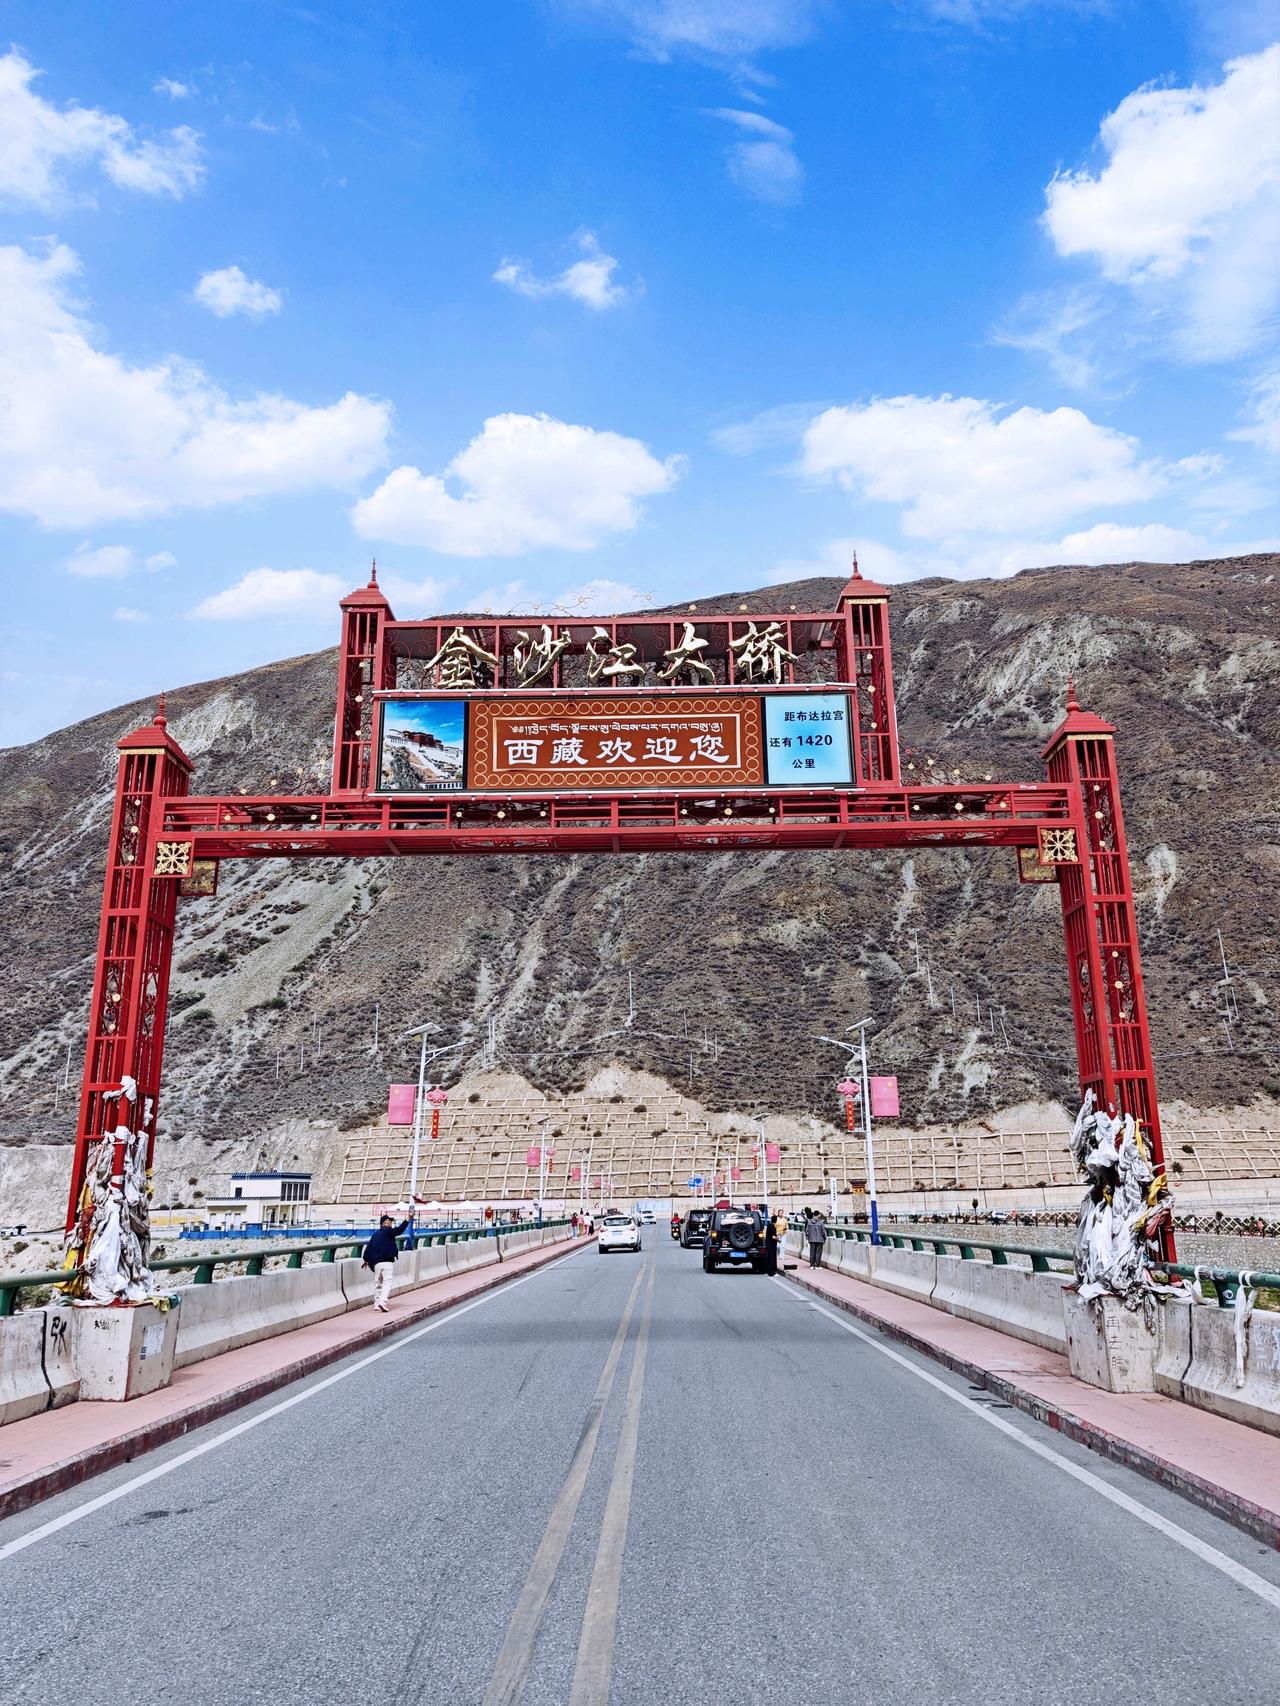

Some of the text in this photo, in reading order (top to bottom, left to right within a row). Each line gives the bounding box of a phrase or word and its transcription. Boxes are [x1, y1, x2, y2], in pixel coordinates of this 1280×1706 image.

[424, 621, 798, 689] 金沙江大桥
[784, 710, 844, 722] 距布达拉宫
[769, 734, 833, 748] 还有 1420
[503, 734, 730, 765] 西藏欢迎您
[792, 758, 816, 769] 公里
